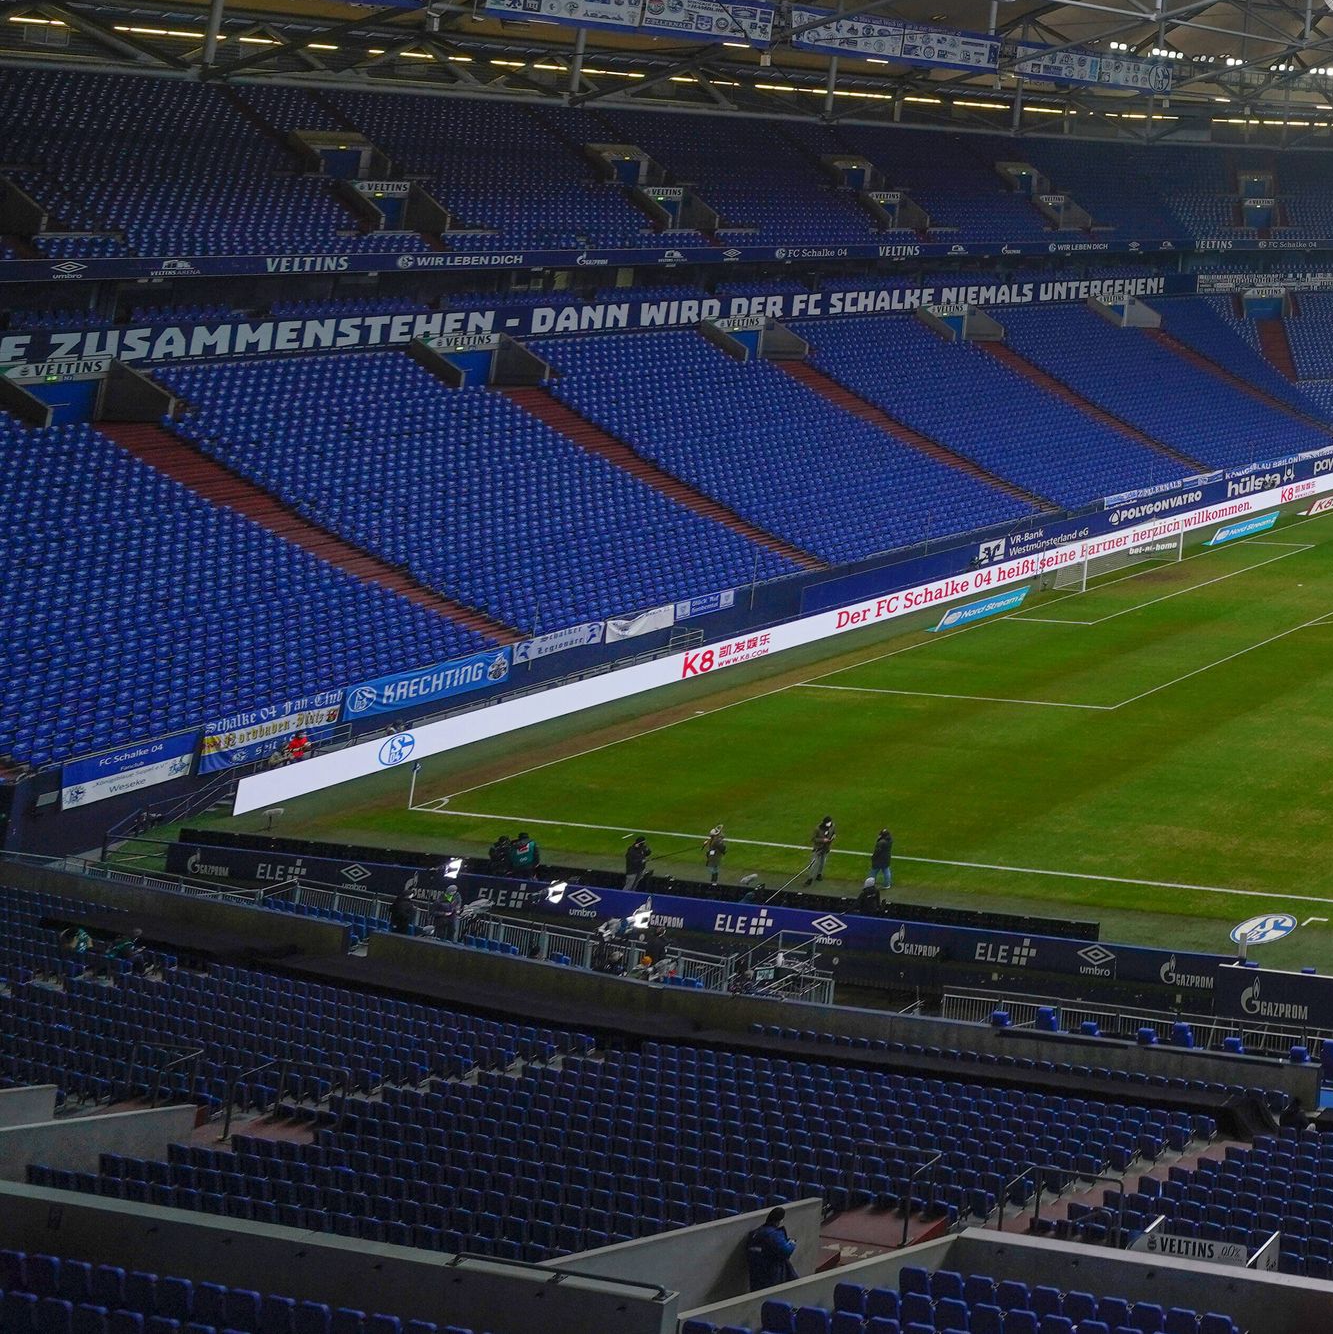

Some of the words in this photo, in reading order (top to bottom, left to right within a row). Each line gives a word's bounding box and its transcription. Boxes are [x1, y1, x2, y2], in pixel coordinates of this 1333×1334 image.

[788, 249, 800, 257] FC
[802, 248, 835, 257] Schalke
[837, 248, 848, 256] 04
[879, 245, 920, 257] VELTINS
[1196, 240, 1233, 249] VELTINS
[265, 256, 349, 272] VELTINS
[417, 257, 443, 266] WIR
[447, 256, 489, 265] LEBEN
[492, 255, 523, 264] DICH
[936, 305, 963, 313] VELTINS
[47, 311, 495, 361] ZUSAMMENSTEHEN
[531, 304, 629, 333] DANN
[640, 299, 720, 326] WIRD
[730, 296, 783, 318] DER
[792, 293, 822, 316] FC
[829, 288, 935, 314] SCHALKE
[942, 283, 1033, 306] NIEMALS
[1039, 277, 1164, 302] UNTERGEHEN!
[727, 318, 760, 328] VELTINS
[446, 335, 491, 347] VELTINS
[35, 360, 102, 377] VELTINS
[1280, 487, 1294, 503] K8
[1119, 490, 1202, 523] POLYGONVATRO
[1009, 531, 1077, 557] Westmünsterland
[1079, 527, 1089, 538] eG
[1010, 528, 1043, 544] VR-Bank
[836, 608, 870, 629] Der
[875, 597, 899, 617] FC
[903, 578, 970, 610] Schalke
[974, 568, 992, 586] 04
[997, 560, 1035, 582] heißt
[1039, 551, 1076, 570] seine
[1080, 536, 1129, 557] Partner
[1183, 501, 1252, 530] willkommen.
[719, 633, 771, 658] 凯发娱乐
[682, 652, 714, 678] K8
[718, 648, 769, 667] WWW.K8.COM
[382, 663, 484, 705] KRECHTING
[205, 712, 257, 734] Schalke
[260, 706, 277, 720] 04
[99, 757, 112, 766] FC
[113, 748, 150, 764] Schalke
[151, 743, 164, 753] 04
[109, 777, 147, 794] Weseke
[256, 864, 286, 881] ELE
[478, 887, 507, 907] ELE
[568, 907, 597, 918] umbro
[715, 914, 746, 934] ELE
[975, 942, 1009, 963] ELE
[1079, 965, 1111, 977] umbro
[1260, 1001, 1308, 1020] GAZPROM
[1159, 1237, 1214, 1259] VELTINS
